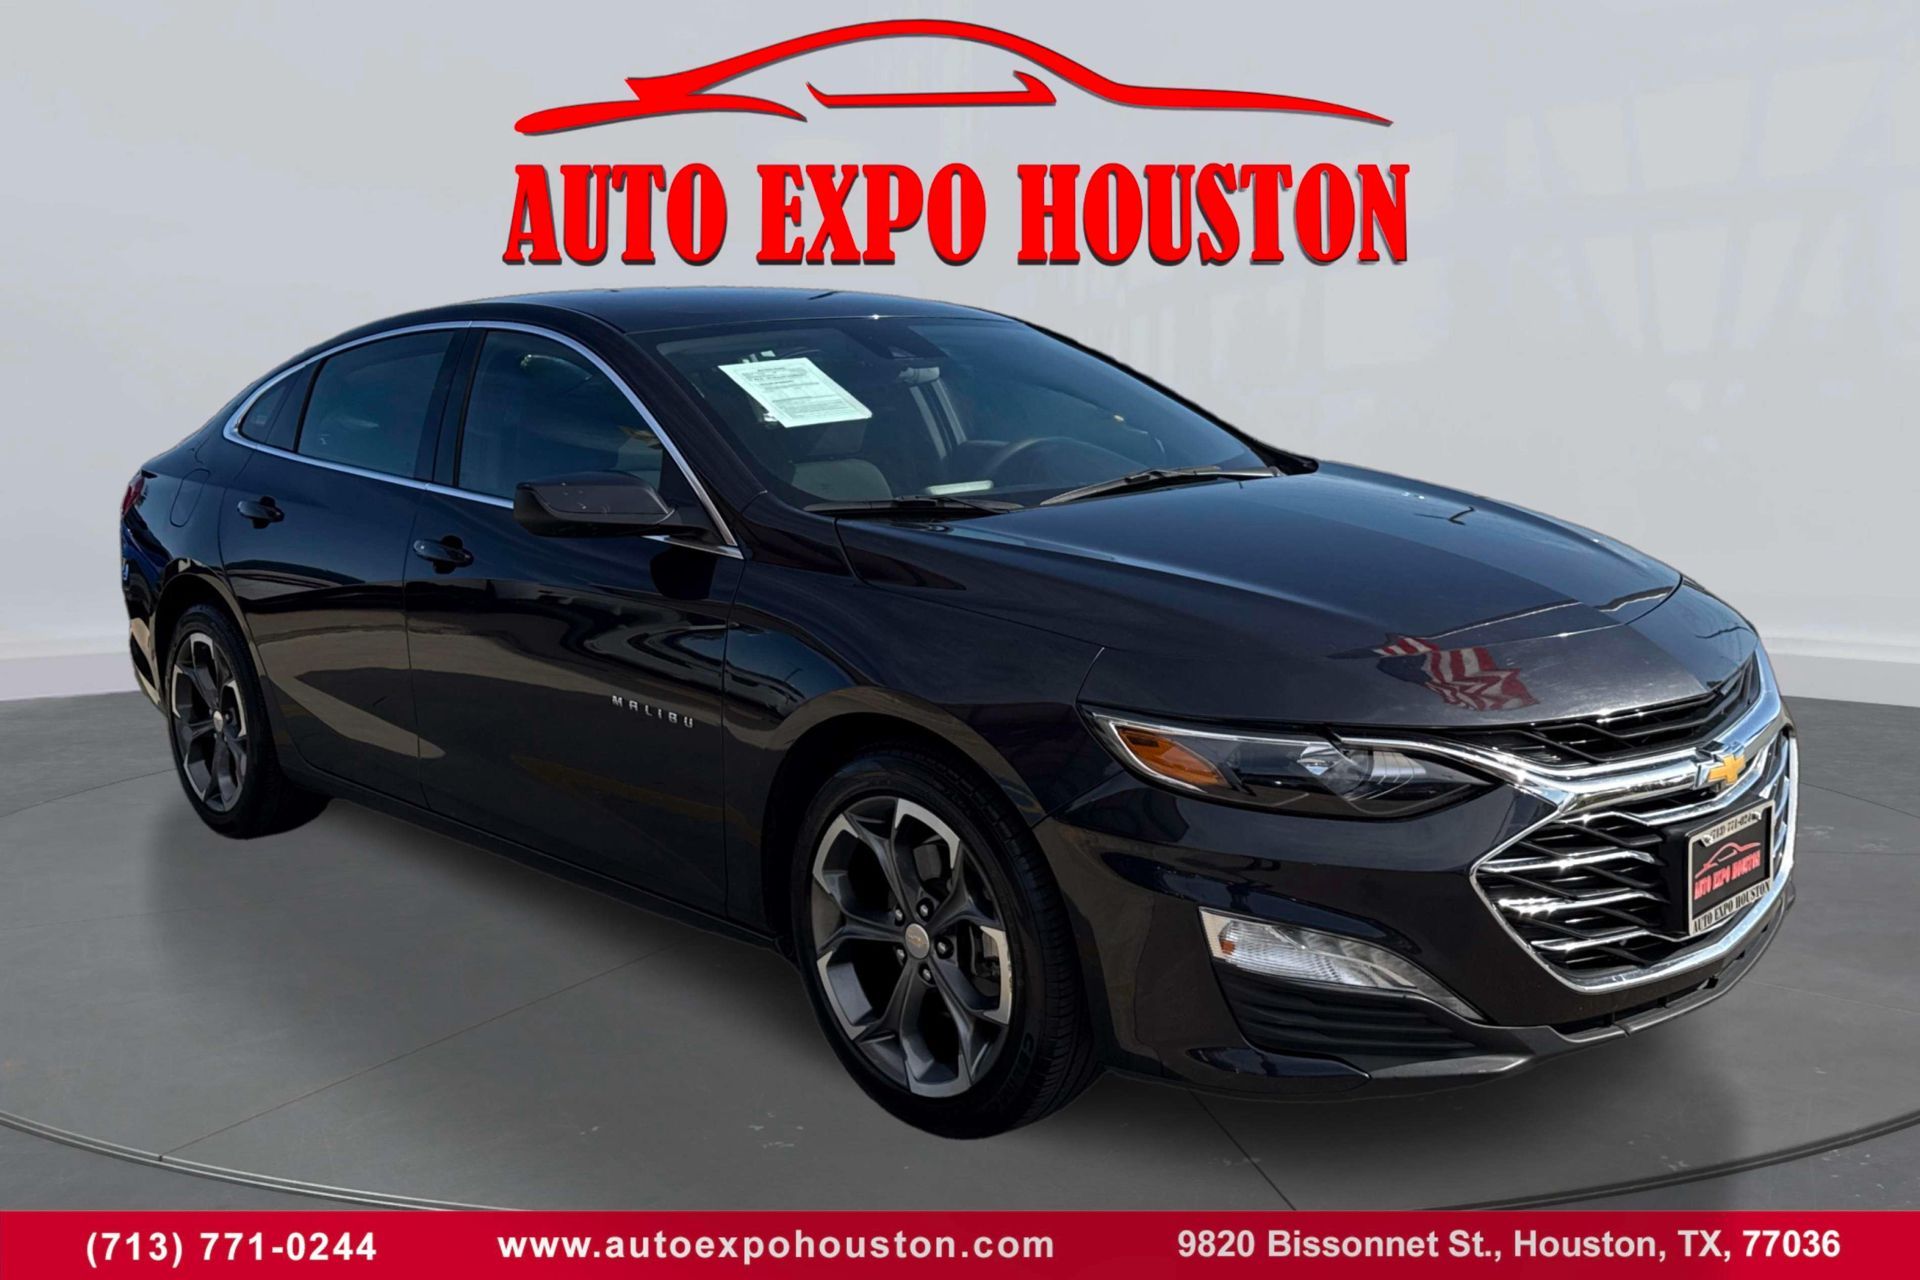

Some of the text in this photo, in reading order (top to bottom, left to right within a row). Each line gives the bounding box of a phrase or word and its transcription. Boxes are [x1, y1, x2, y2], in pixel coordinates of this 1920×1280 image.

[612, 695, 693, 728] MALIBU
[1694, 875, 1711, 900] AUTO
[1692, 882, 1771, 934] AUTO EXPO HOUSTON
